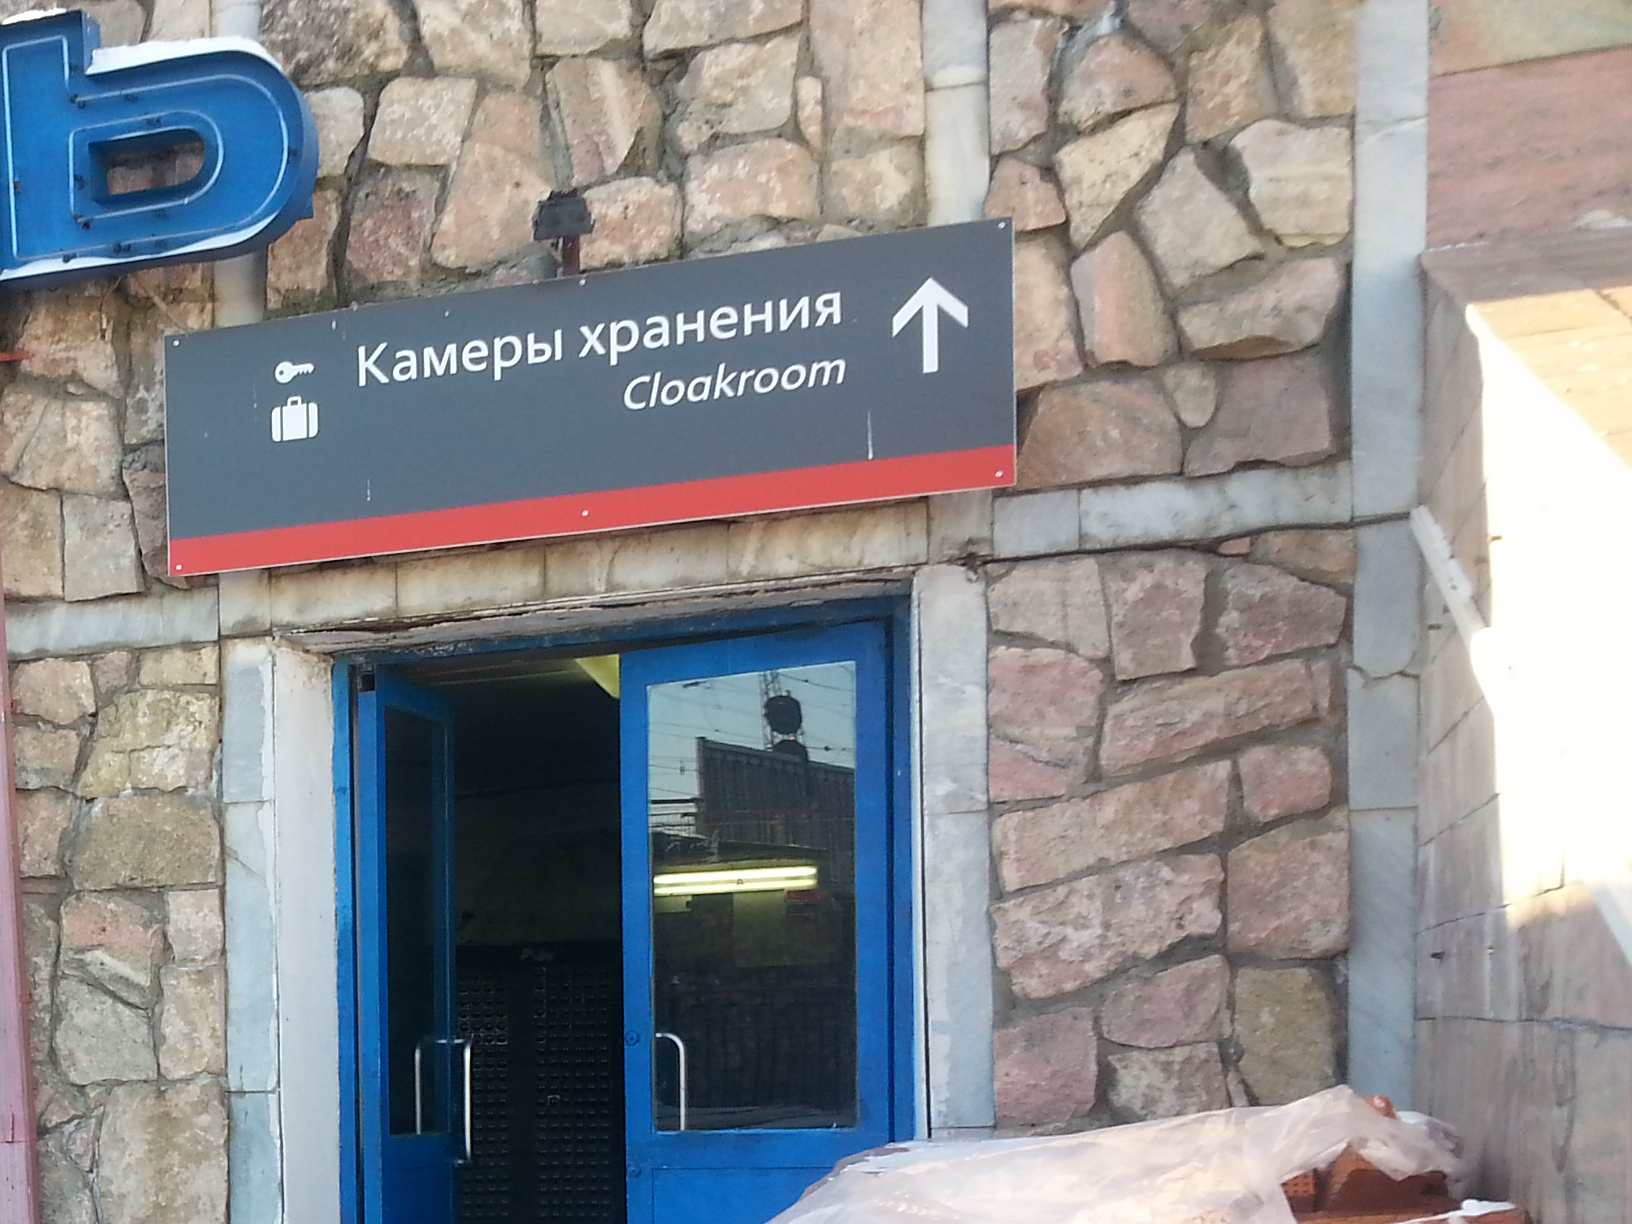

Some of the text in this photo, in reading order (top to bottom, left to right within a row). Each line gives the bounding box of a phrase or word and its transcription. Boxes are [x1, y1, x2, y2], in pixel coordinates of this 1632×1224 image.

[356, 289, 843, 387] Камеры хранения
[622, 351, 847, 412] Cloakroom
